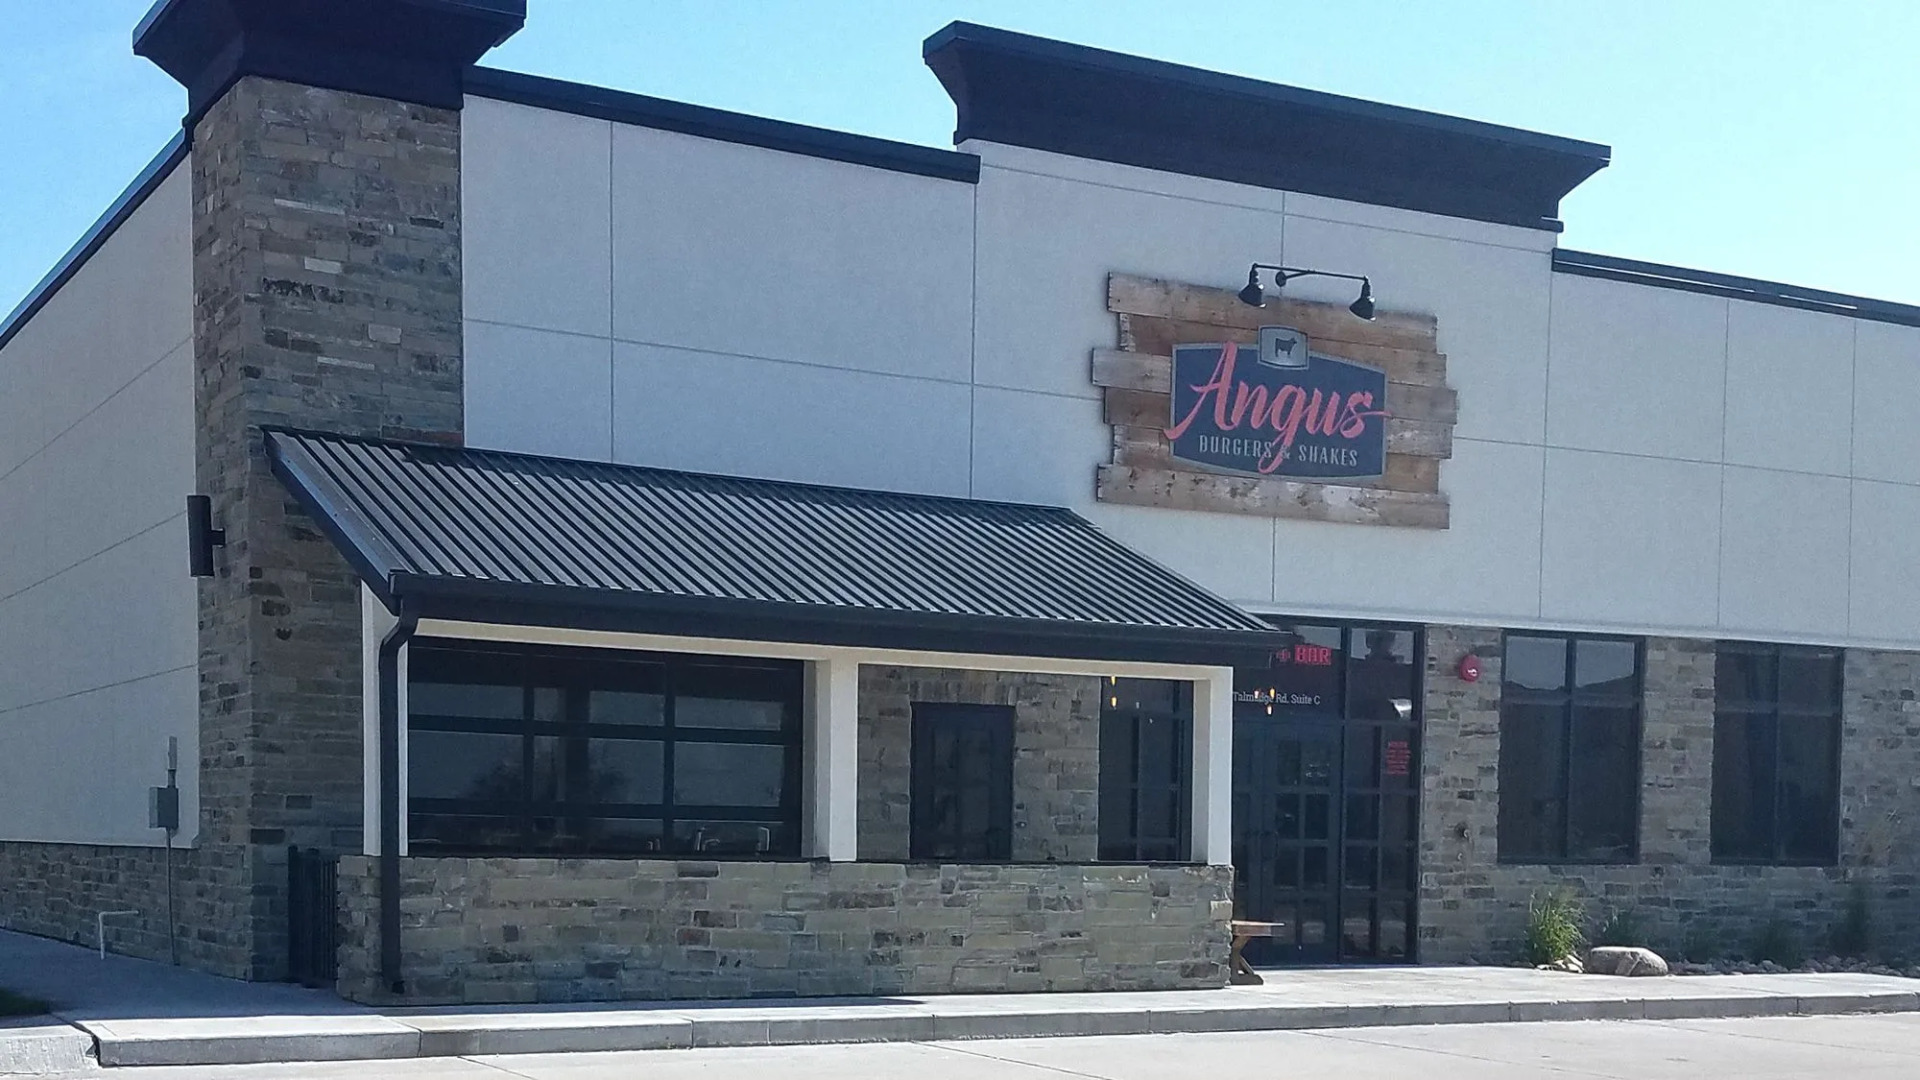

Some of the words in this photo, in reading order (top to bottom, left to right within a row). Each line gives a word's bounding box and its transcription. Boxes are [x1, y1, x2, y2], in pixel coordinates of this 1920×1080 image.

[1163, 341, 1391, 474] Angus
[1199, 435, 1272, 458] BURGERS
[1280, 445, 1291, 460] &
[1299, 444, 1358, 467] SHAKES
[1295, 645, 1331, 665] BAR
[1233, 691, 1274, 705] Talmdge
[1276, 692, 1289, 704] Rd.
[1290, 694, 1312, 704] Suite
[1313, 695, 1321, 705] C
